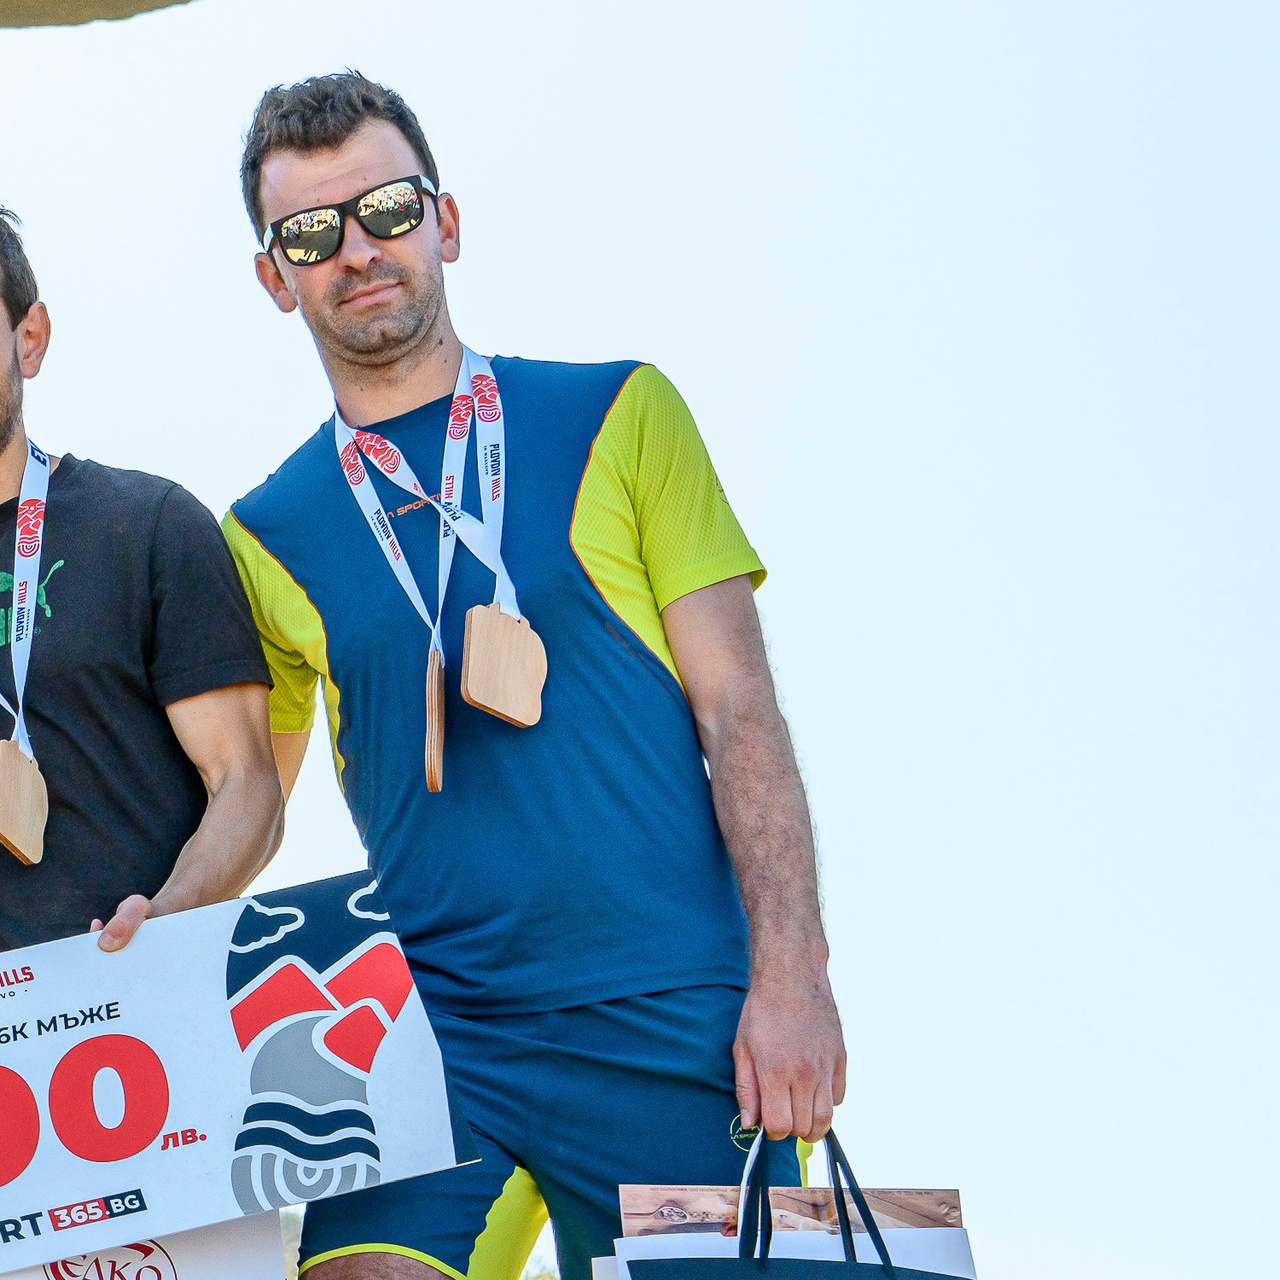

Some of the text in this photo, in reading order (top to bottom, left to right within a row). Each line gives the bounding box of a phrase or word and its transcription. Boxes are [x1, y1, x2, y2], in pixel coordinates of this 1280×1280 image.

[444, 475, 455, 500] HILLS
[17, 580, 28, 605] HILLS
[16, 607, 26, 643] PLOVDIV
[37, 1001, 121, 1036] МЪЖЕ
